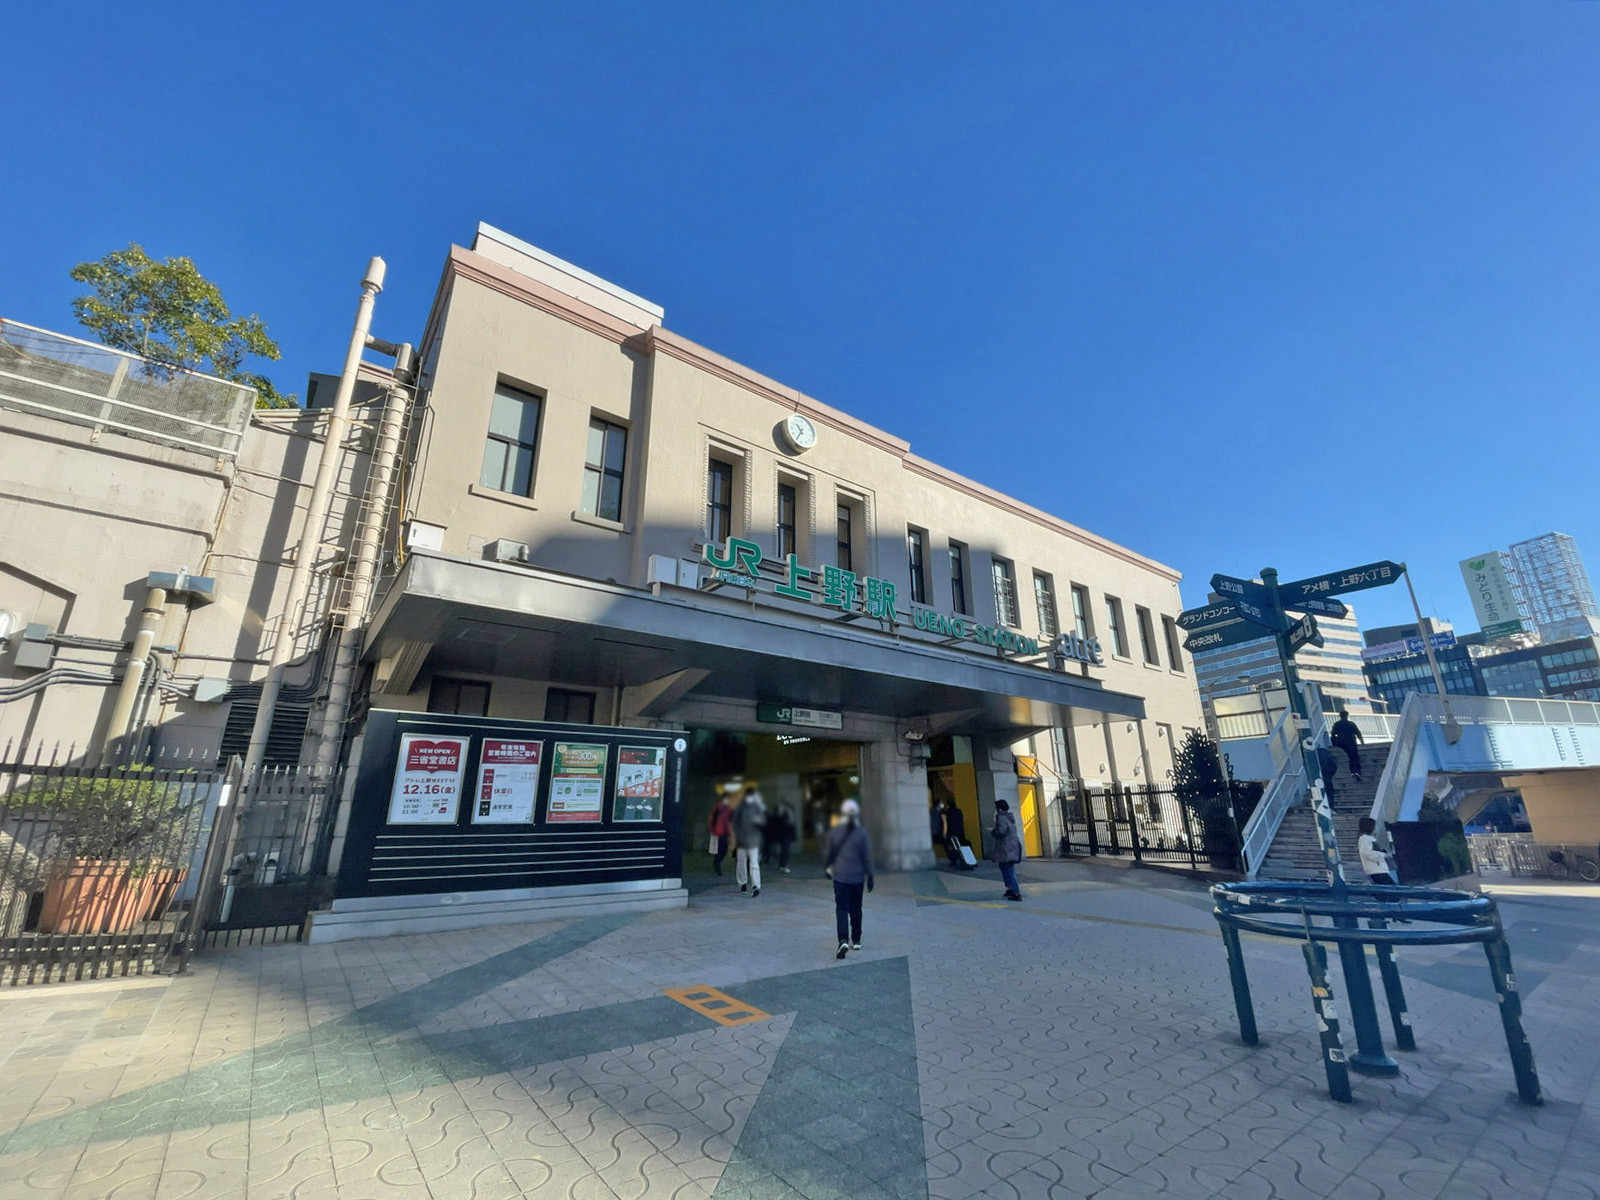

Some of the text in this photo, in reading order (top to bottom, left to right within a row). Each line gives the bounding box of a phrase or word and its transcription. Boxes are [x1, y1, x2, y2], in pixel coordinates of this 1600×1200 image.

[703, 536, 898, 621] JR 上野駅
[1219, 580, 1244, 595] 上野公園
[1302, 566, 1391, 595] アメ横・上野六丁目
[1475, 573, 1500, 621] みどり生命
[913, 608, 1040, 656] UENO STATION
[1188, 632, 1223, 649] 中央改札
[776, 708, 791, 719] JR
[409, 755, 457, 765] 三省堂書店
